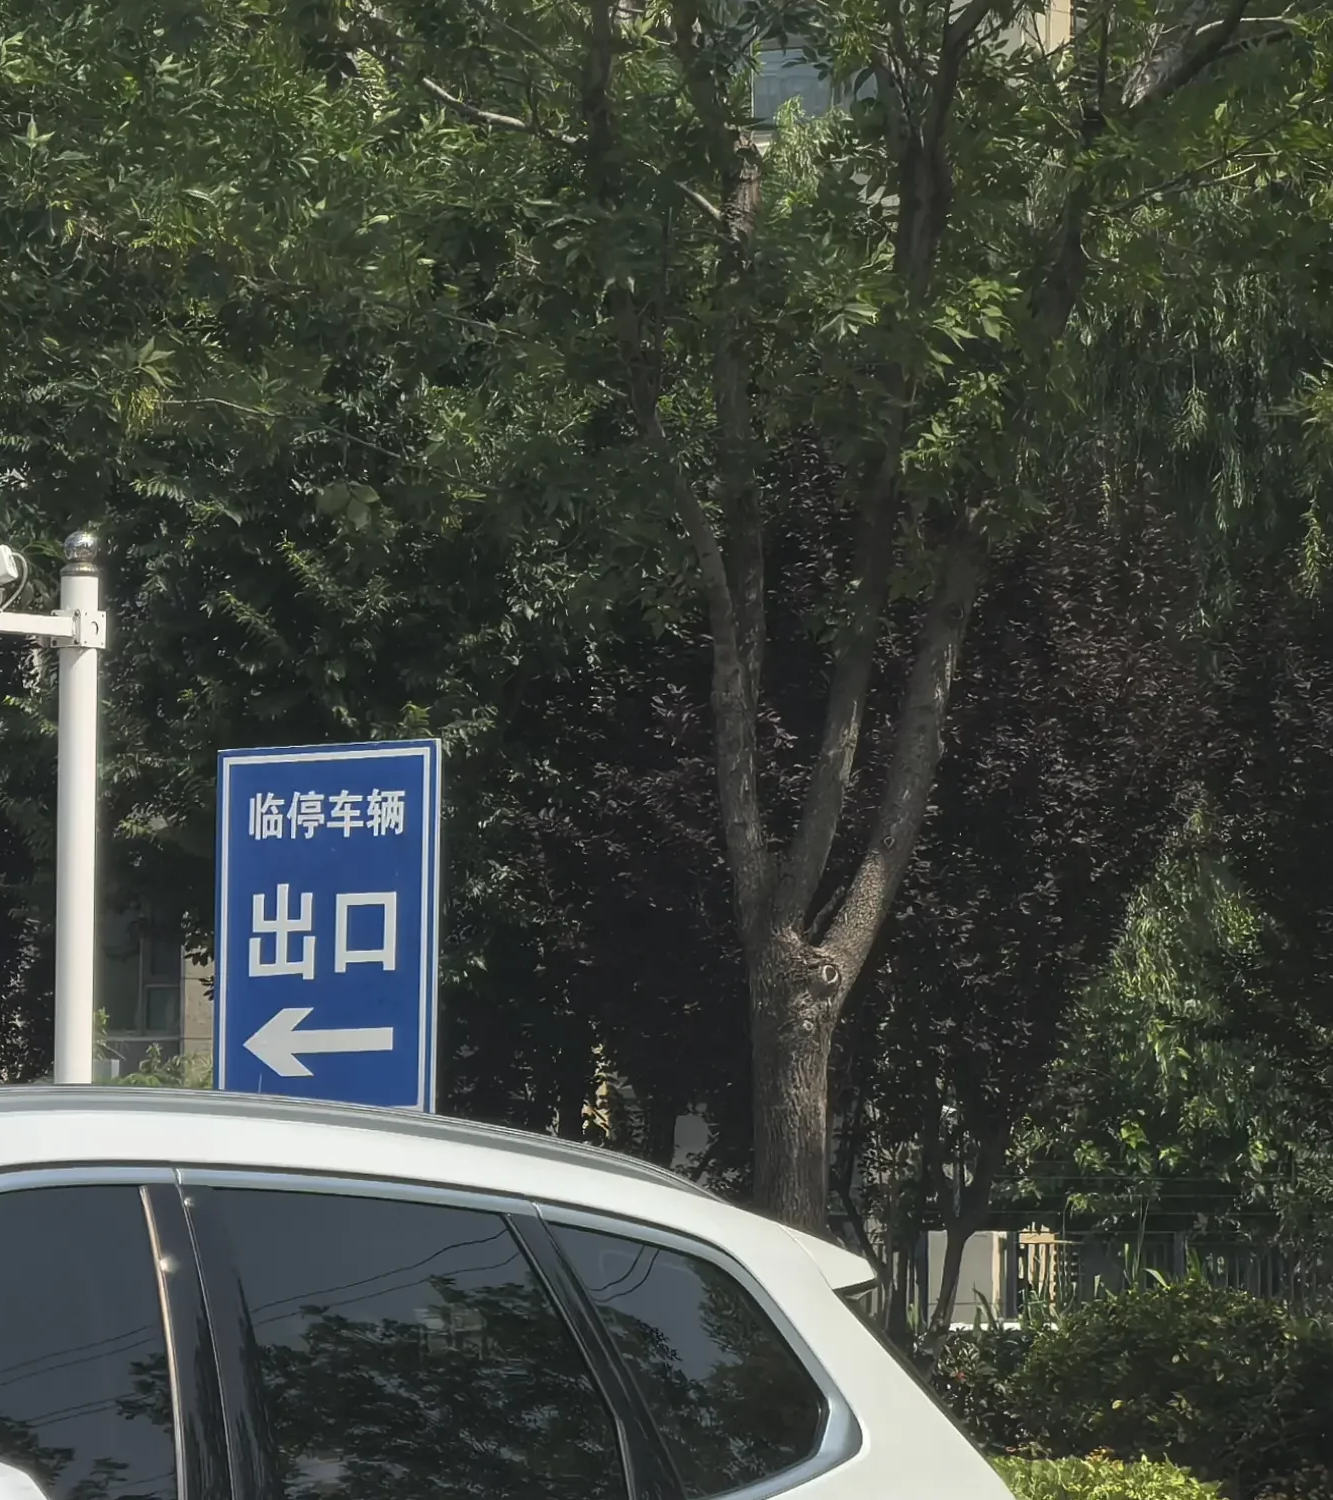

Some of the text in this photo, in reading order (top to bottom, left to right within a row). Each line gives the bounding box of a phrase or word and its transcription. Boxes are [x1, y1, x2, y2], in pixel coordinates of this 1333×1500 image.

[248, 788, 406, 840] 临停车辆
[248, 882, 398, 980] 出口
